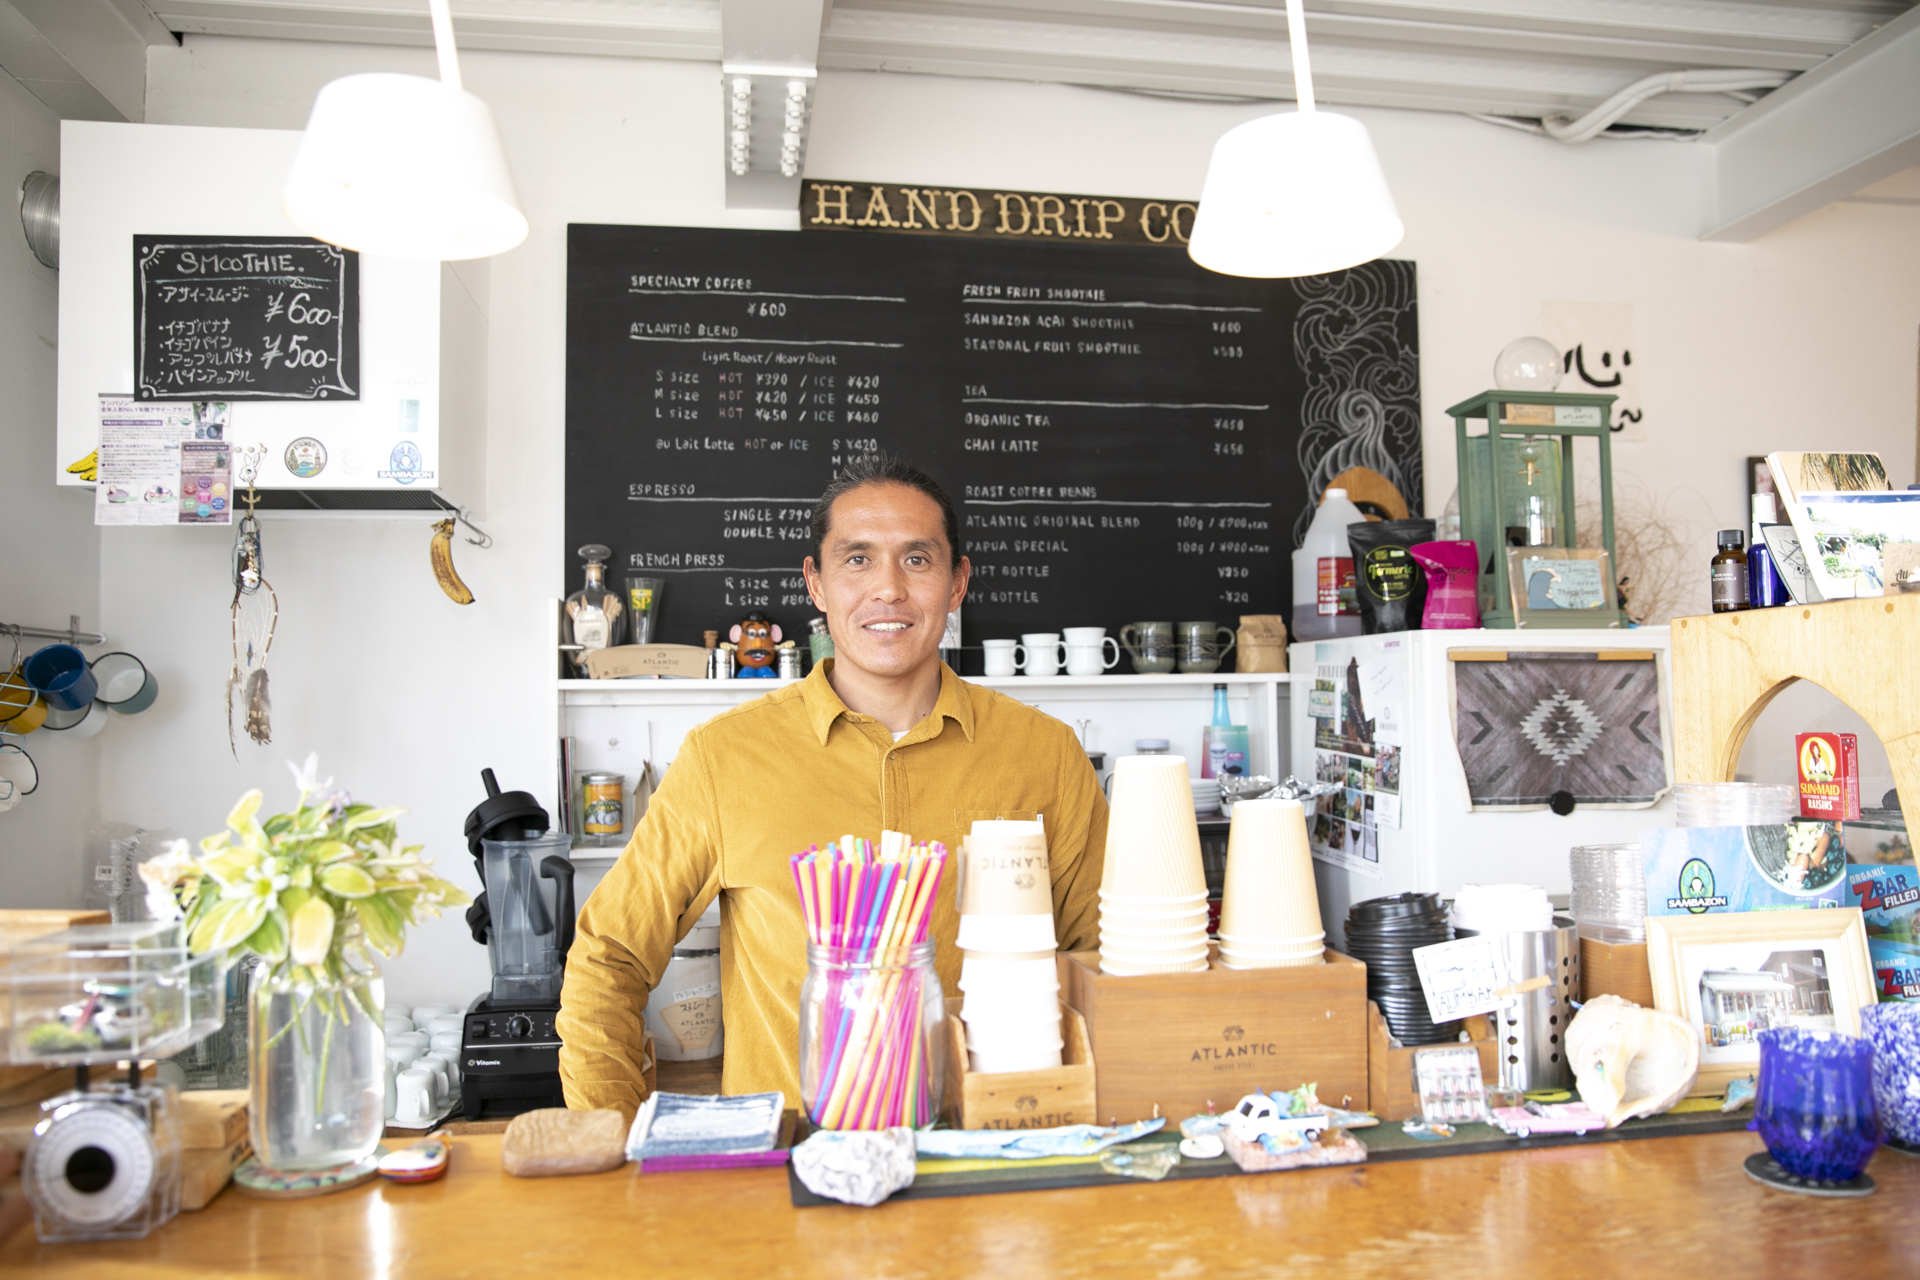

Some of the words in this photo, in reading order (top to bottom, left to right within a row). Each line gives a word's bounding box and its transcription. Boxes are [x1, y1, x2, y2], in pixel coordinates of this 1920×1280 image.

[810, 184, 983, 232] HAND
[994, 191, 1127, 240] DRIP
[1139, 200, 1200, 244] CO
[630, 274, 701, 288] SPECIALTY
[705, 277, 752, 290] COFFEE
[963, 283, 1001, 298] FRESH
[1006, 286, 1042, 299] FRUIT
[1047, 288, 1107, 301] SMOOTHIE
[746, 302, 787, 317] ¥600
[964, 312, 1031, 327] SAMBAZON
[1071, 316, 1136, 330] SMOOTHIE
[630, 321, 692, 336] ATLANTIC
[698, 323, 739, 338] BLEND
[964, 337, 1031, 353] SEASONAL
[1034, 340, 1072, 354] FRUIT
[1077, 341, 1142, 356] SMOOTHIE
[702, 351, 732, 364] Light
[733, 352, 764, 364] Roast
[807, 352, 838, 365] Roast
[655, 370, 664, 382] S
[670, 371, 700, 384] size
[719, 372, 744, 384] HOT
[755, 372, 789, 386] ¥390
[813, 375, 836, 388] ICE
[846, 375, 880, 389] ¥420
[654, 388, 664, 400] M
[670, 388, 700, 402] size
[719, 390, 744, 402] HOT
[755, 391, 788, 404] ¥420
[813, 393, 836, 405] ICE
[846, 393, 880, 406] ¥450
[964, 385, 988, 397] TEA
[655, 406, 663, 418] L
[669, 406, 699, 419] size
[719, 408, 744, 419] HOT
[755, 408, 788, 422] ¥450
[813, 411, 836, 423] ICE
[965, 412, 1021, 427] ORGANIC
[1024, 413, 1051, 427] TEA
[675, 437, 699, 451] Lait
[704, 436, 735, 451] Latte
[744, 439, 768, 450] HOT
[770, 439, 784, 451] or
[789, 438, 810, 451] ICE
[832, 438, 841, 451] S
[964, 438, 996, 452] CHAI
[1002, 439, 1039, 453] LATTE
[847, 454, 880, 467] ¥40
[378, 471, 433, 479] SAMBAZON
[629, 483, 695, 496] ESPRESSO
[965, 485, 1004, 498] ROAST
[1009, 486, 1054, 499] COFFEE
[1059, 486, 1098, 499] BEANS
[724, 508, 773, 522] SINGLE
[965, 515, 1028, 529] ATLANTIC
[1033, 515, 1095, 529] ORIGINAL
[1101, 516, 1141, 529] BLEND
[724, 525, 775, 539] DOUBLE
[965, 541, 1009, 554] PAPUA
[1014, 540, 1070, 553] SPECIAL
[630, 553, 681, 567] FRENCH
[685, 553, 725, 567] PRESS
[1001, 566, 1050, 578] BOTTLE
[725, 576, 734, 589] R
[739, 576, 770, 589] size
[779, 576, 805, 589] ¥60
[725, 594, 733, 606] L
[739, 593, 769, 606] size
[990, 591, 1040, 604] BOTTLE
[642, 658, 680, 666] ATLANTIC
[1807, 798, 1834, 812] RAISINS
[1849, 866, 1887, 884] ORGANIC
[1667, 895, 1727, 909] SAMBAZON
[1884, 888, 1919, 908] FILLED
[1875, 957, 1908, 969] ORGANIC
[680, 1018, 716, 1026] ATLANTIC
[1191, 1043, 1277, 1062] ATLANTIC
[981, 1111, 1075, 1130] ATLANTIC
